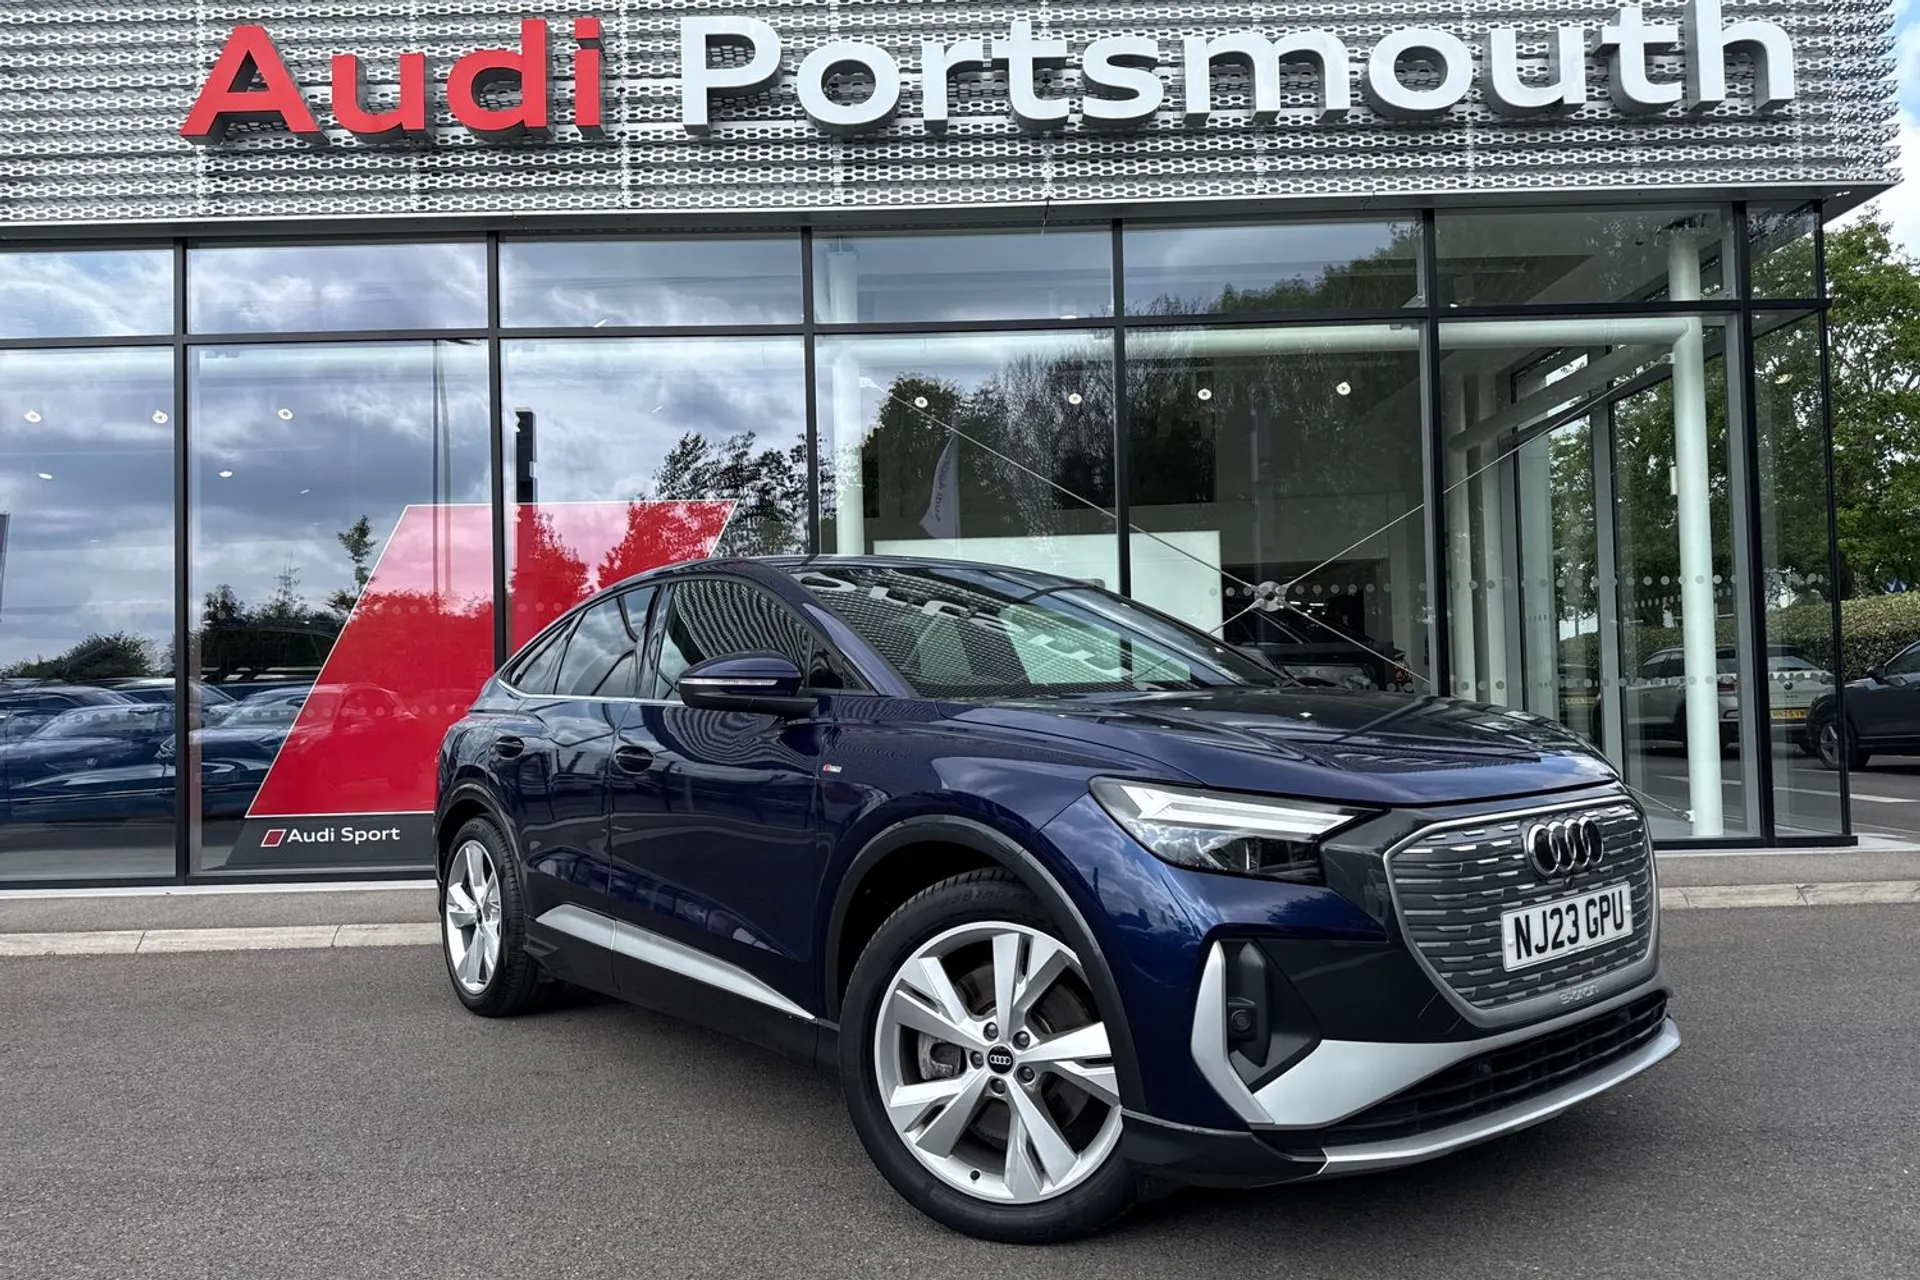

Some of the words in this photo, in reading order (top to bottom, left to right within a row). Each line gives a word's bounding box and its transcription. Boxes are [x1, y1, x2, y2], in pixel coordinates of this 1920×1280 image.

[180, 17, 604, 143] Audi
[681, 0, 1795, 134] Portsmouth
[286, 827, 335, 843] Audi
[341, 827, 400, 844] Sport
[1514, 903, 1579, 960] NJ23
[1585, 890, 1624, 939] GPU
